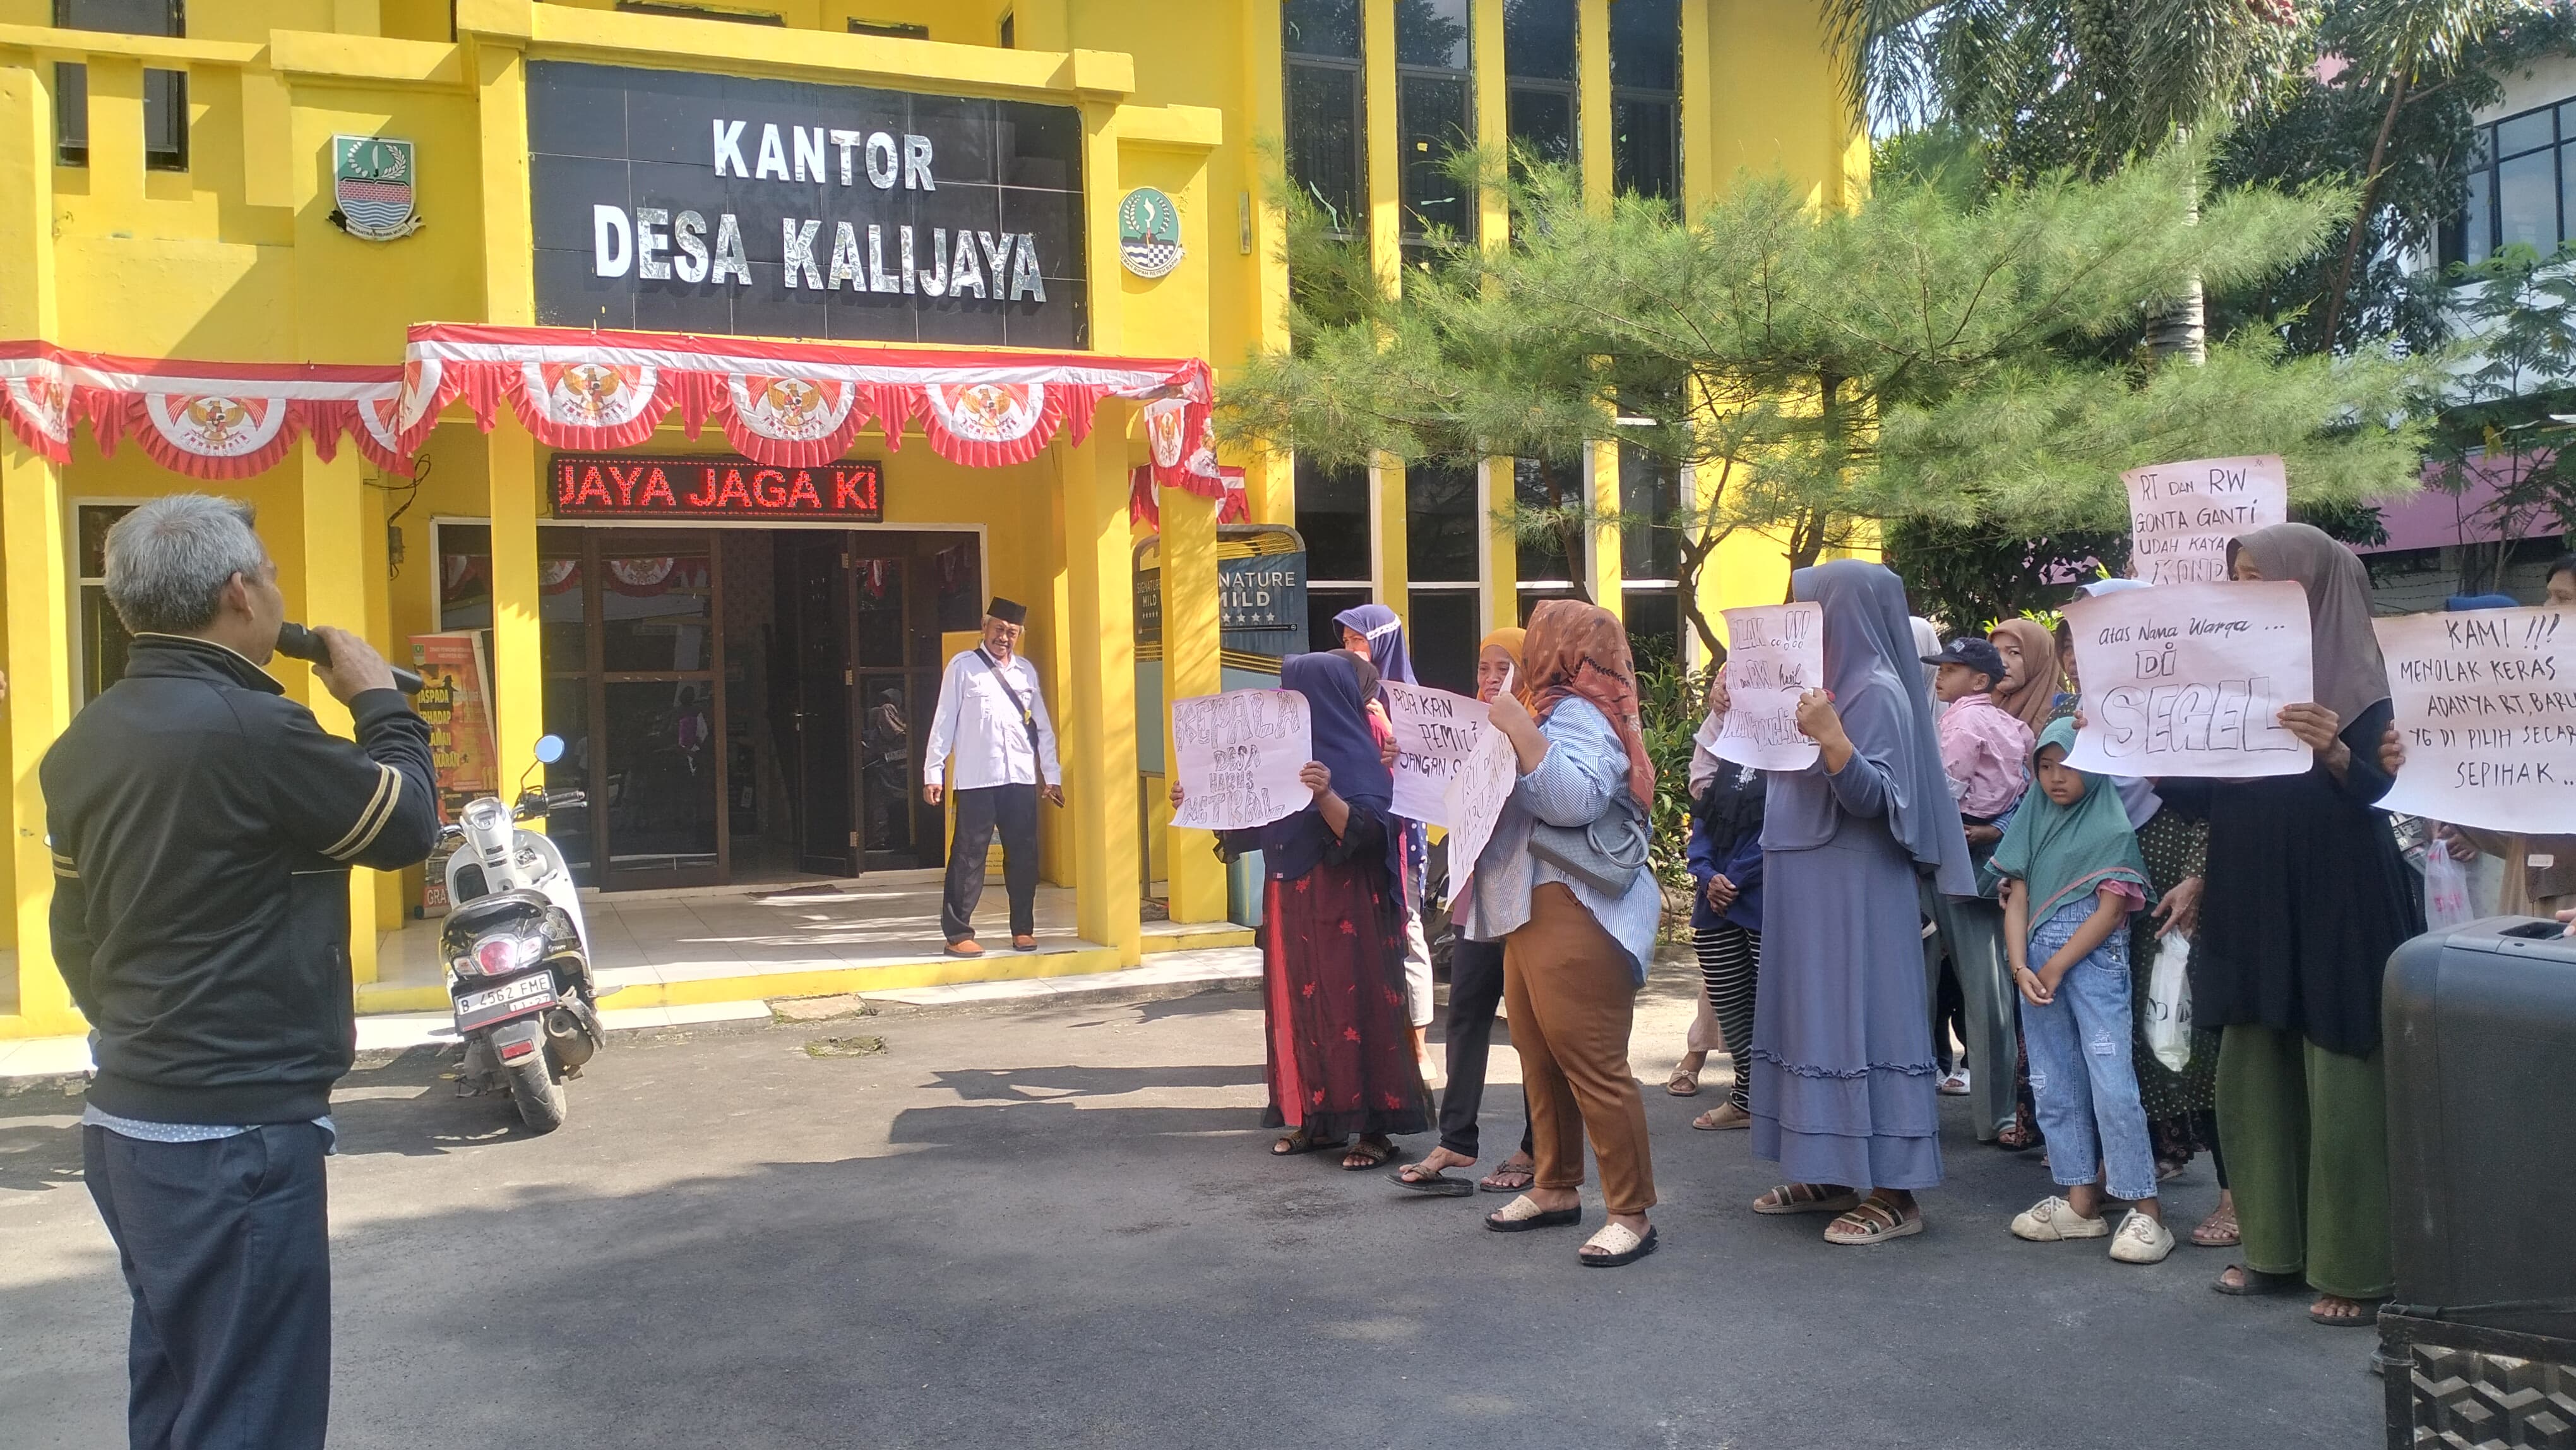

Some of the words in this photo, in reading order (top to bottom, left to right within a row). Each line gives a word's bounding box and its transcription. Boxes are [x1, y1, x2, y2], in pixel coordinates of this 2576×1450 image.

[712, 118, 936, 191] KANTOR
[593, 203, 753, 285] DESA
[782, 217, 1047, 303] KALIJAYA
[560, 465, 677, 506] JAYA
[689, 468, 823, 508] JAGA
[2142, 473, 2158, 501] RT
[2169, 479, 2195, 496] DAN
[2209, 467, 2247, 495] RW
[2135, 510, 2190, 534] GONTA
[2138, 537, 2179, 556] UDAH
[2188, 537, 2225, 552] KAYA
[1218, 571, 1296, 587] NATURE
[2150, 558, 2229, 585] KOND
[1143, 594, 1157, 608] MILD
[2400, 658, 2483, 684] MENOLAK
[2490, 656, 2556, 685] KERAS
[418, 689, 449, 703] ASPADA
[2427, 695, 2496, 718] ADANYA
[419, 710, 451, 724] RHADAP
[1174, 691, 1301, 752] KEPALA
[2101, 676, 2300, 758] SEGEL
[429, 732, 451, 746] AMAN
[2440, 729, 2456, 747] DI
[2468, 728, 2512, 750] PILIH
[2522, 724, 2576, 746] SECAR
[1213, 744, 1261, 772] DESA
[1399, 751, 1447, 778] JANGAN
[2454, 761, 2555, 789] SEPIHAK
[1179, 788, 1285, 827] NETRAL
[461, 999, 470, 1013] B
[520, 976, 548, 995] FME
